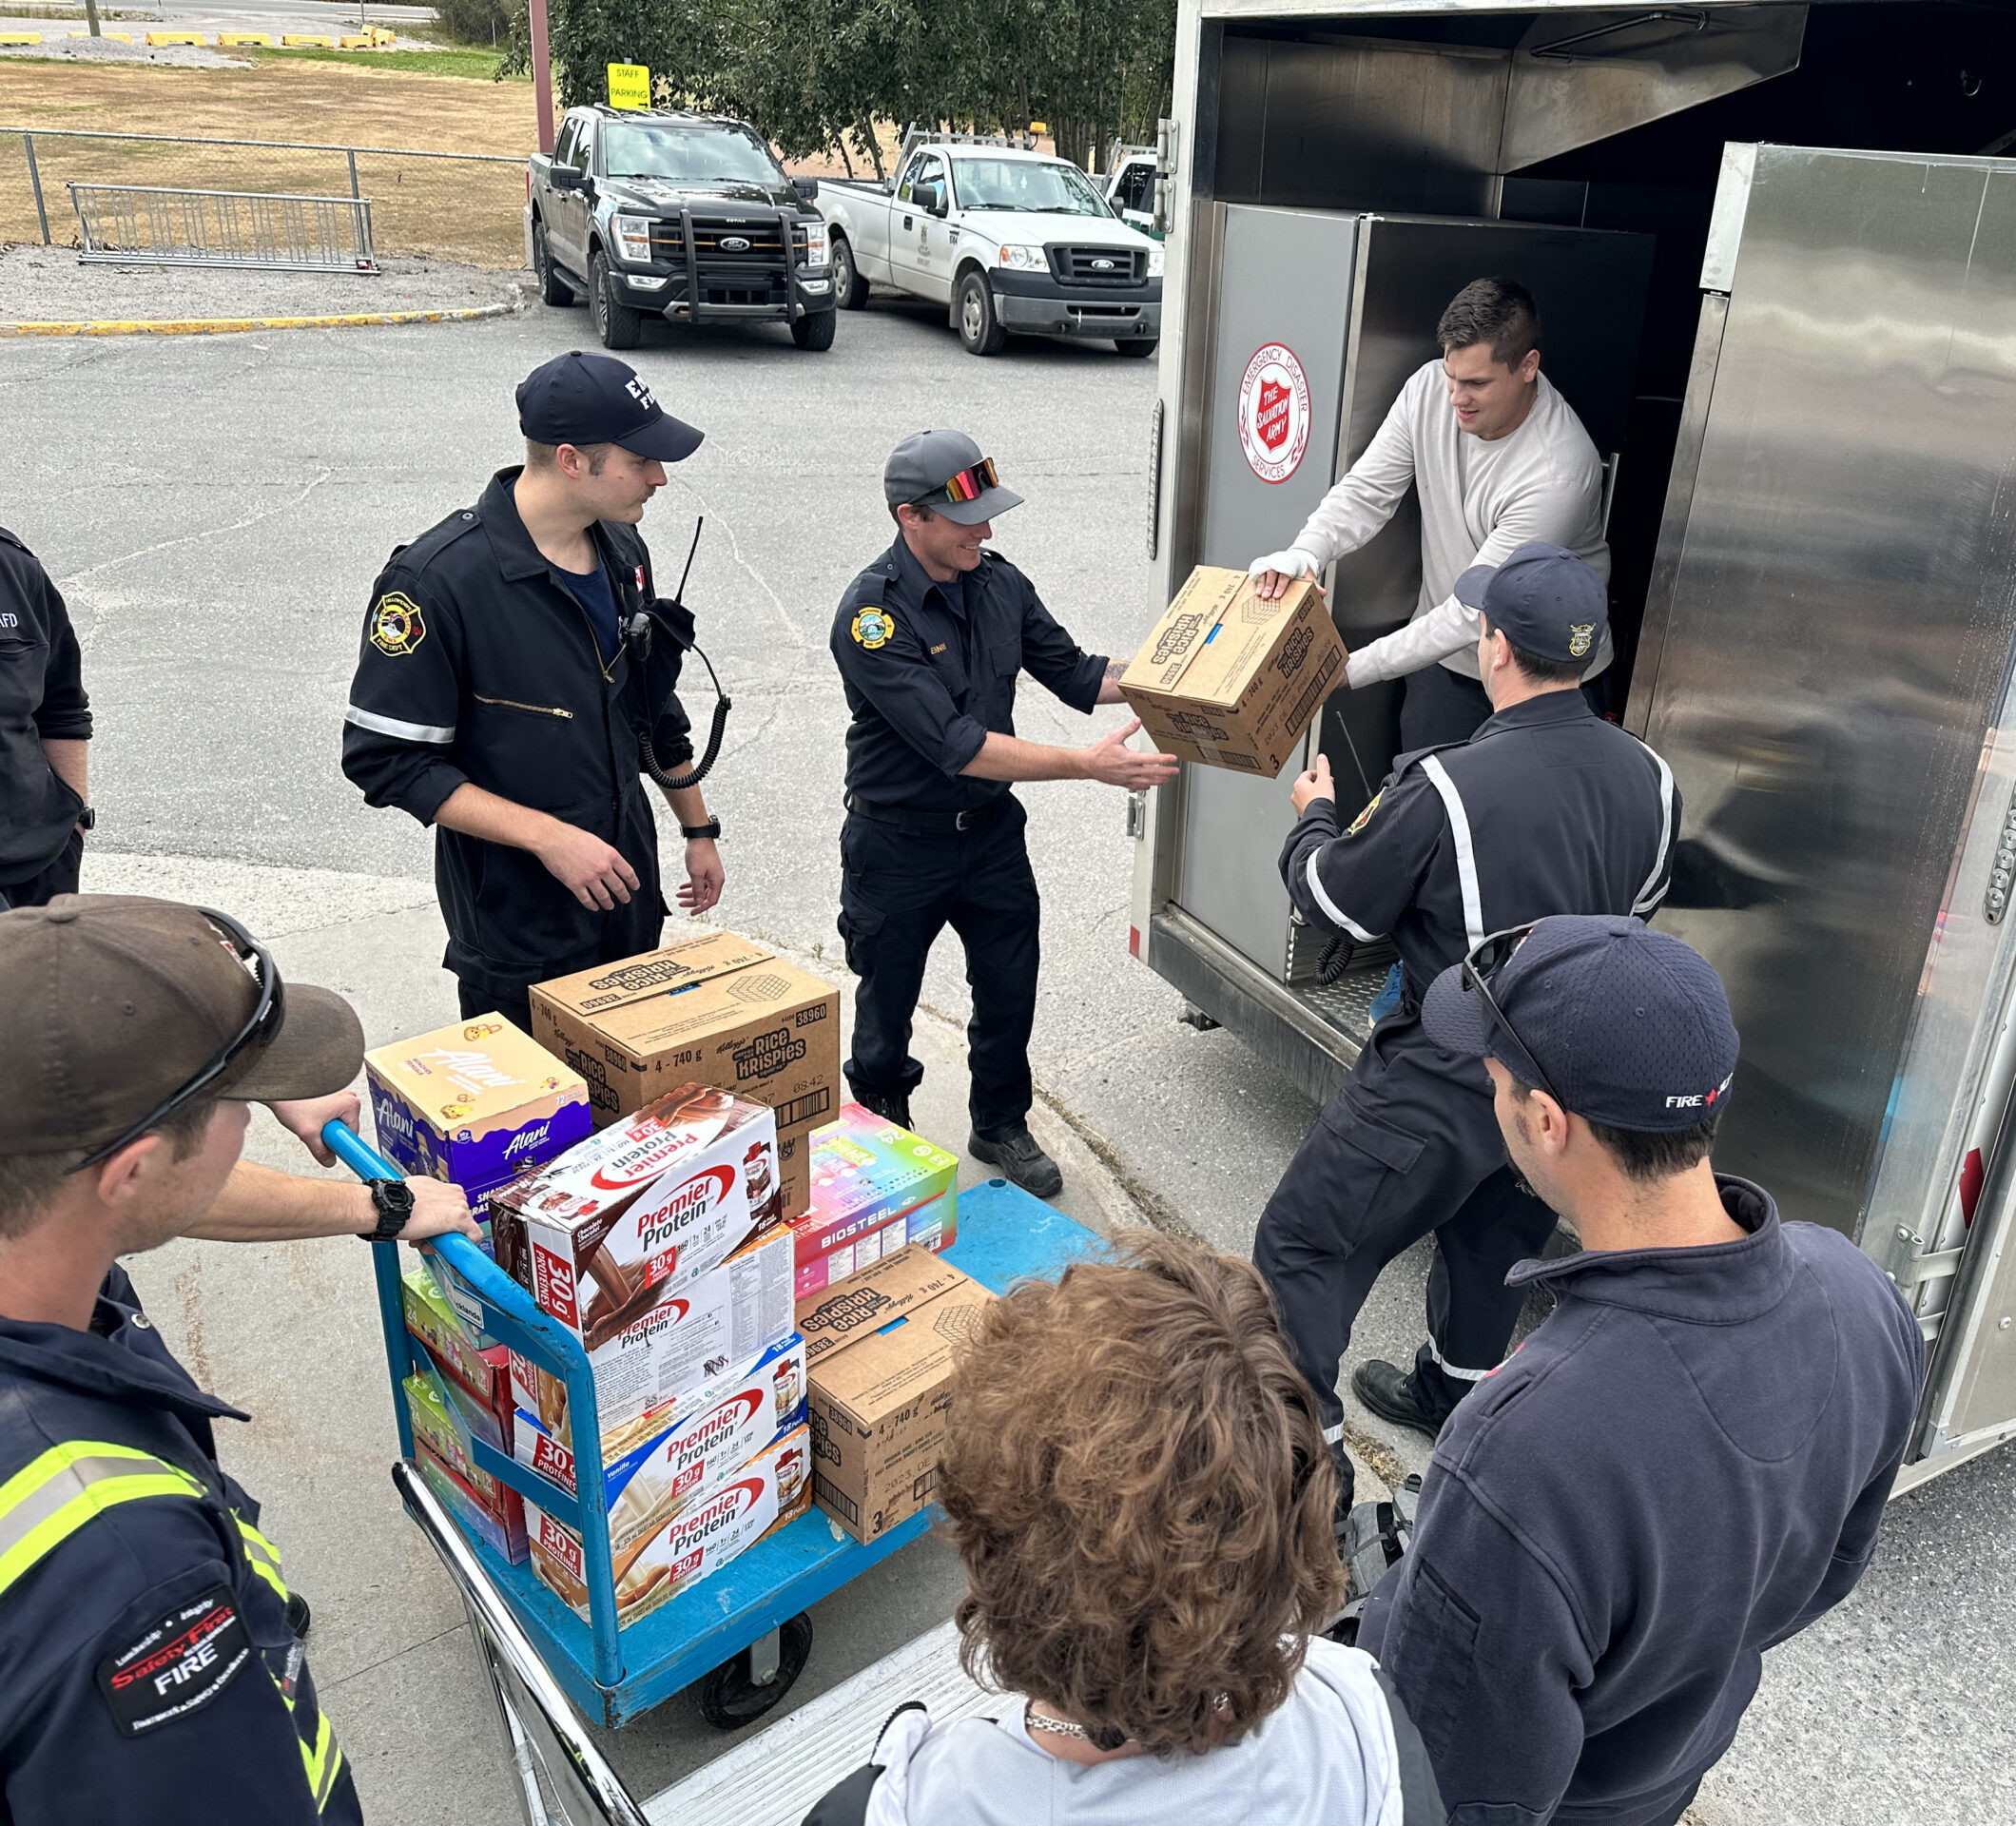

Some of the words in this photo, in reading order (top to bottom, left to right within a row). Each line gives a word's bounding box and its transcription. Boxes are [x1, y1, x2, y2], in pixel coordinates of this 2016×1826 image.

[616, 68, 639, 78] STAFF
[611, 87, 648, 99] PARKING
[1242, 348, 1283, 395] EMERGENCY
[1286, 355, 1308, 412] DISASTER
[1263, 386, 1279, 406] THE
[1256, 395, 1289, 430] SALVATION
[1266, 416, 1288, 442] ARMY
[1251, 455, 1286, 479] SERVICES
[1270, 753, 1280, 770] 3
[532, 998, 536, 1011] 4
[540, 1003, 552, 1021] 740
[797, 1004, 825, 1027] 38960
[418, 1047, 527, 1088] Alani
[655, 1059, 663, 1073] 4
[673, 1050, 692, 1068] 740
[695, 1049, 703, 1062] g
[1666, 1095, 1703, 1108] FIRE
[377, 1097, 414, 1139] Alani
[643, 1118, 663, 1138] 30
[502, 1121, 551, 1160] Alani
[612, 1130, 677, 1170] Protein
[625, 1132, 699, 1178] Premier
[637, 1176, 713, 1239] Premier
[643, 1199, 707, 1253] Protein
[676, 1239, 689, 1253] 160
[703, 1224, 711, 1234] 24
[757, 1218, 766, 1232] 18
[821, 1206, 898, 1249] BIOSTEEL
[535, 1250, 551, 1308] PROTÉINES
[548, 1257, 573, 1300] 30
[649, 1255, 666, 1277] 30
[927, 1279, 943, 1292] 740
[406, 1305, 418, 1324] 24
[618, 1306, 673, 1342] Premier
[621, 1319, 669, 1350] Protein
[772, 1344, 784, 1352] 18
[410, 1406, 422, 1425] 24
[783, 1423, 792, 1434] 18
[878, 1424, 884, 1435] 4
[894, 1408, 911, 1428] 740
[666, 1402, 743, 1464] Premier
[540, 1438, 568, 1468] 30
[676, 1425, 735, 1471] Protein
[537, 1459, 577, 1492] PROTÉINES
[607, 1461, 630, 1479] Vanilla
[675, 1471, 693, 1489] 30
[674, 1478, 699, 1497] PROTEIN
[669, 1488, 743, 1545] Premier
[872, 1510, 883, 1534] 3
[543, 1521, 568, 1551] 30
[673, 1506, 736, 1557] Protein
[543, 1538, 578, 1574] PROTÉINES
[673, 1559, 691, 1576] 30
[672, 1563, 699, 1584] PROTEIN
[110, 1642, 186, 1690] Safety
[186, 1607, 234, 1645] First
[153, 1641, 219, 1696] FIRE
